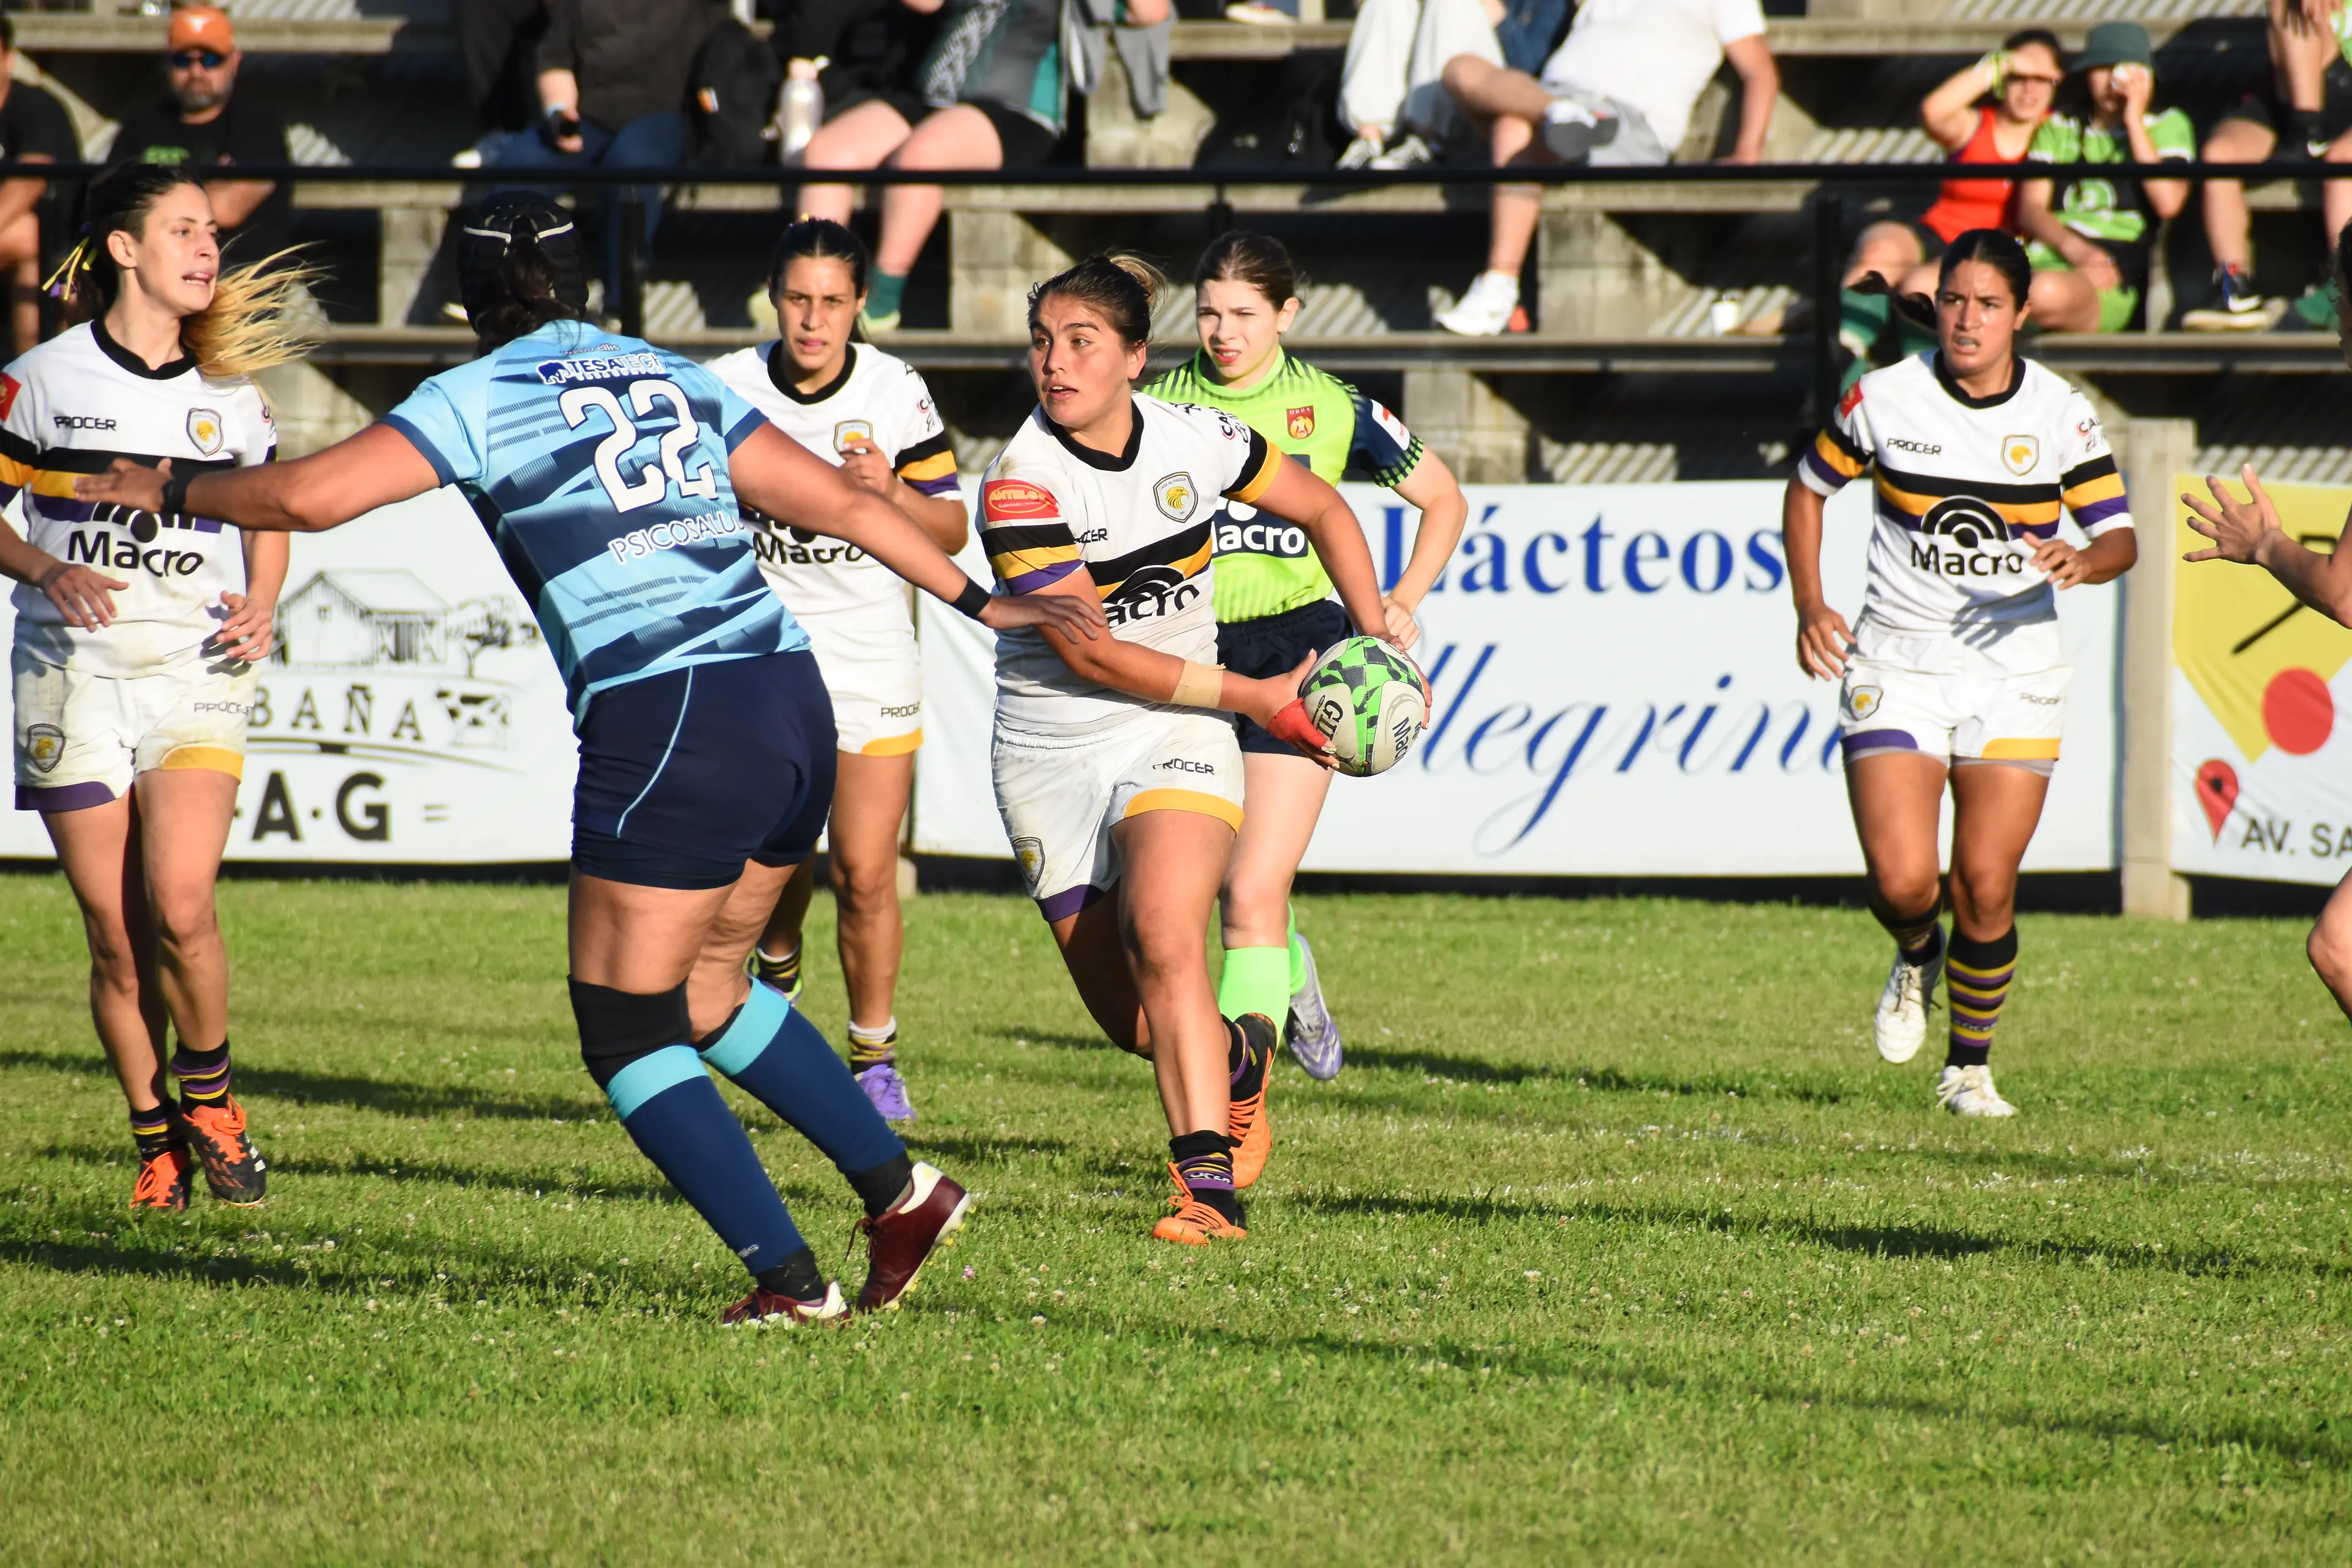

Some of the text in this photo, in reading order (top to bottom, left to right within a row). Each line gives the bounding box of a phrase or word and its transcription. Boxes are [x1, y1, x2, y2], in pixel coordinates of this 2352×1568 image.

[54, 416, 116, 431] PROCER
[558, 379, 719, 514] 22
[1887, 438, 1942, 455] PROCER
[67, 530, 204, 577] Macro
[753, 532, 866, 564] Macro
[1374, 503, 1784, 594] Lácteos
[1910, 541, 2023, 576] Macro
[1103, 584, 1200, 628] acro
[247, 684, 425, 742] BAÑA
[2240, 818, 2296, 856] AV.
